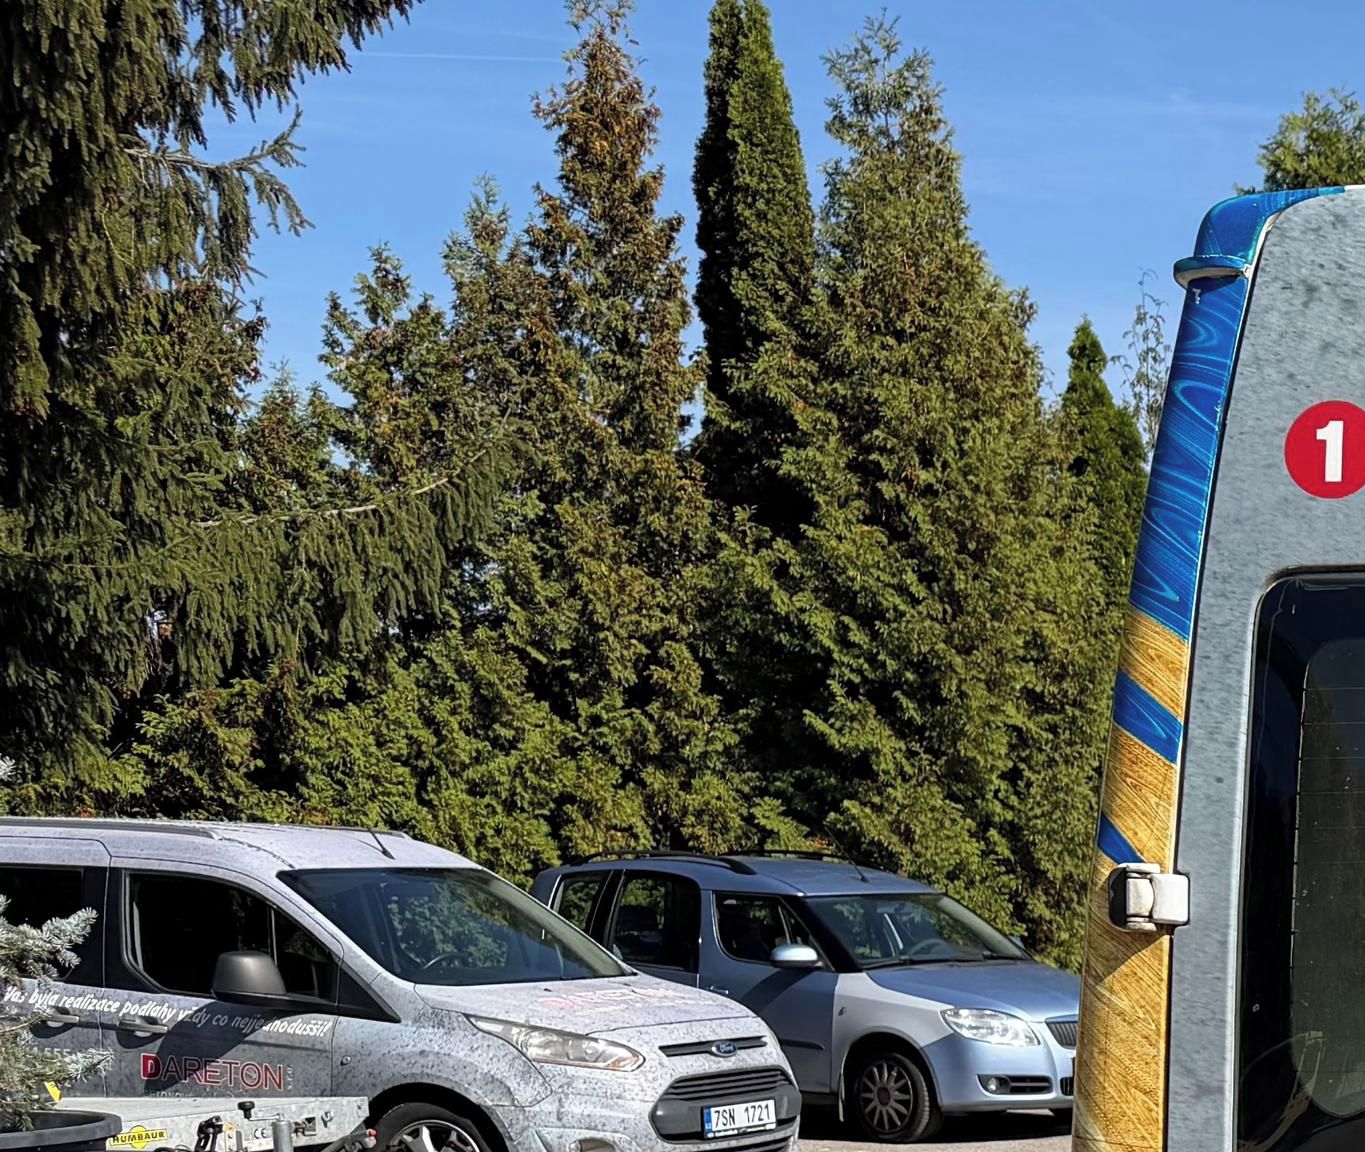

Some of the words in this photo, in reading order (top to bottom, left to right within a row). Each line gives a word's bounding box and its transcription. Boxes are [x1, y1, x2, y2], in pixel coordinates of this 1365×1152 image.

[1315, 420, 1344, 482] 1
[59, 993, 122, 1013] realizace
[119, 1001, 177, 1023] podlahy
[177, 1006, 211, 1028] vždy
[212, 1014, 228, 1027] co
[140, 1053, 284, 1091] DARETON
[713, 1107, 736, 1128] 7SN
[744, 1103, 771, 1124] 1721
[112, 1131, 165, 1144] HUMBAUR
